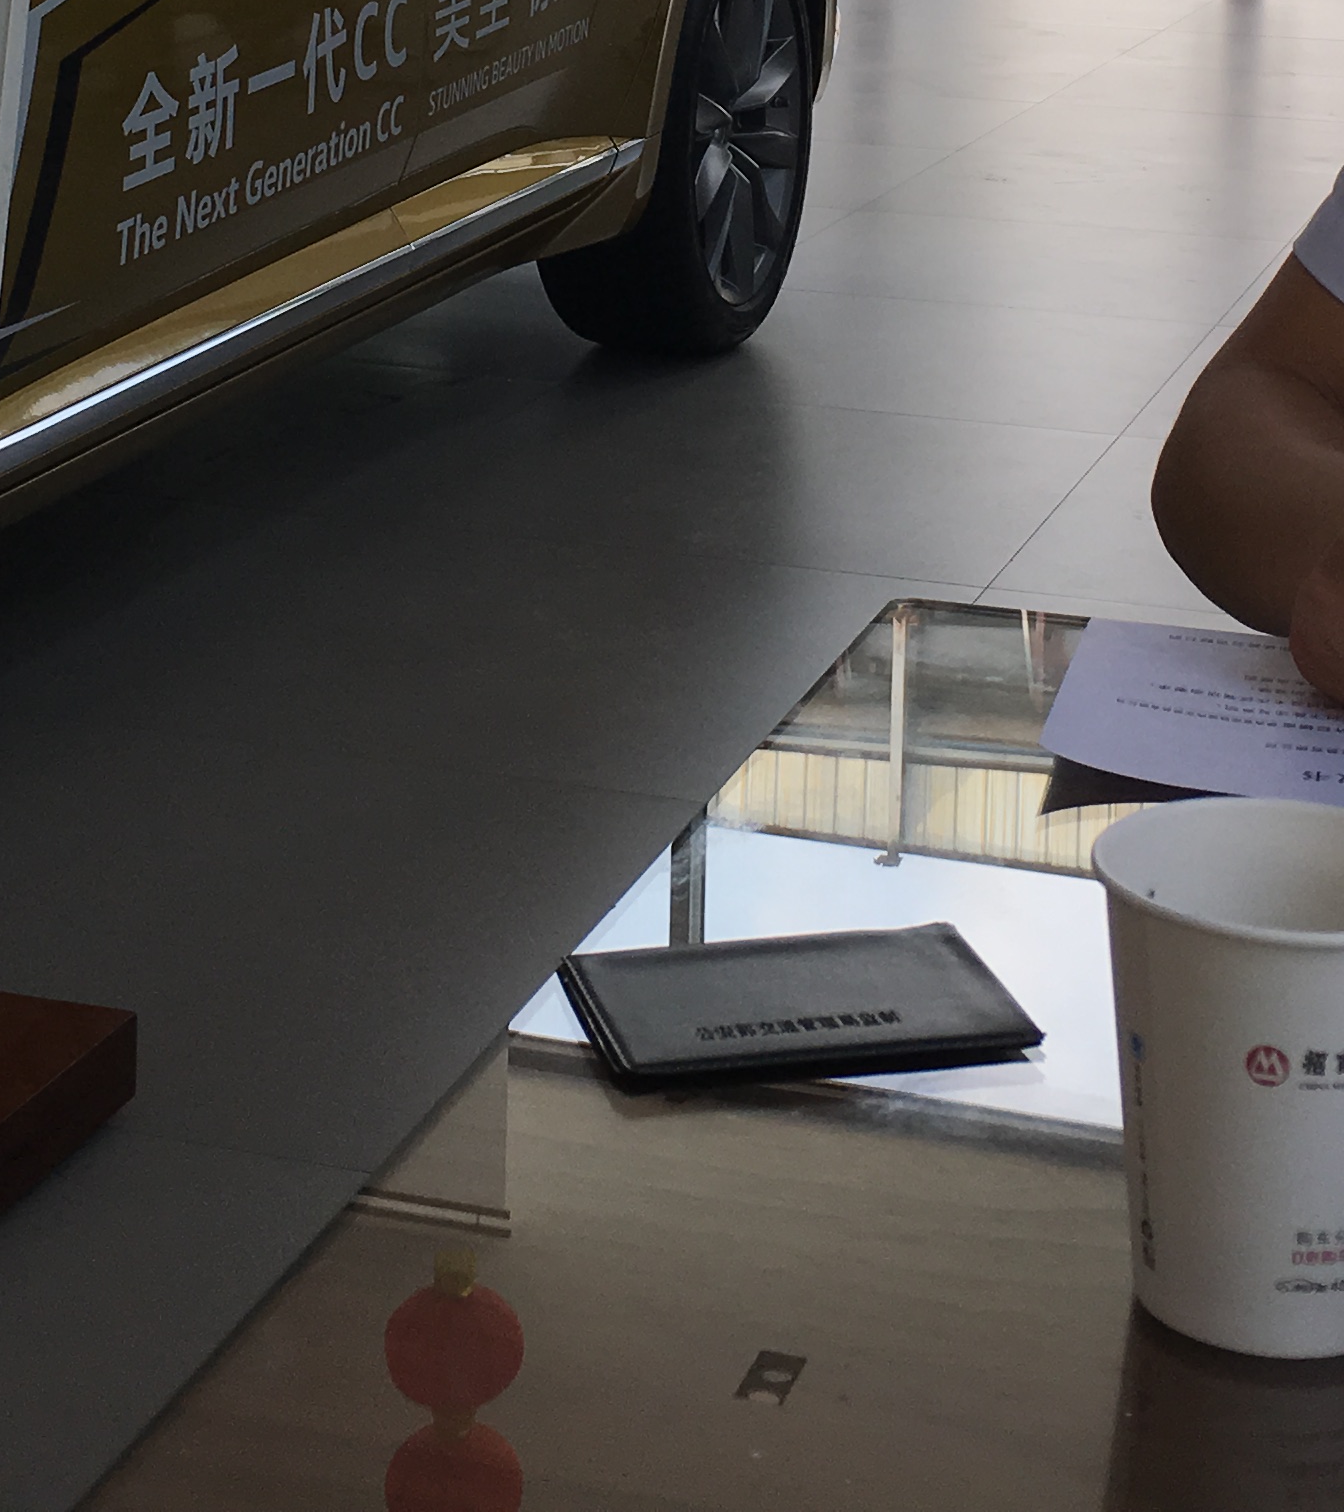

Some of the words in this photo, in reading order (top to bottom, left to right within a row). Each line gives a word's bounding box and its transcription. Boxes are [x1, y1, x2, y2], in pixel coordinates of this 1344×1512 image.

[428, 65, 490, 117] STUNNING
[491, 44, 534, 86] BEAUTY
[535, 34, 547, 61] IN
[548, 17, 590, 56] MOTION
[117, 212, 167, 266] The
[175, 176, 239, 240] Next
[245, 120, 371, 206] Generation
[377, 95, 405, 143] CC
